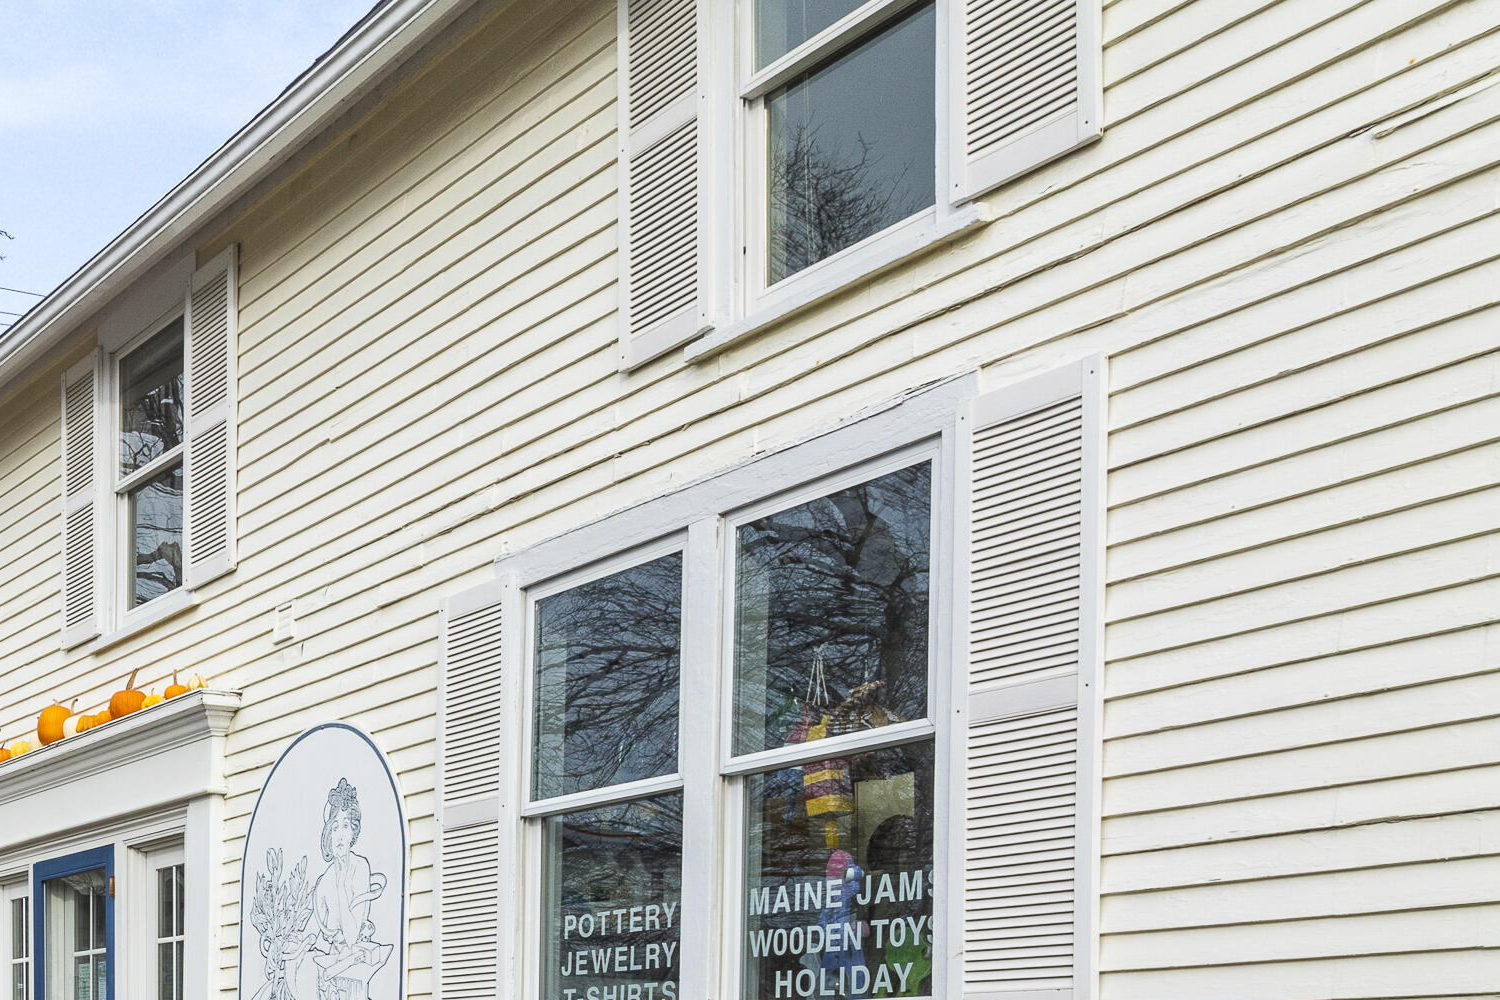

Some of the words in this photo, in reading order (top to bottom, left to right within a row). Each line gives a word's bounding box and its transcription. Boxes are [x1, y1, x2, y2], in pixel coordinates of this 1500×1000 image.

[749, 879, 843, 915] MAINE
[563, 902, 677, 940] POTTERY
[749, 921, 862, 958] WOODEN
[561, 941, 677, 977] JEWELRY
[775, 962, 914, 999] HOLIDAY
